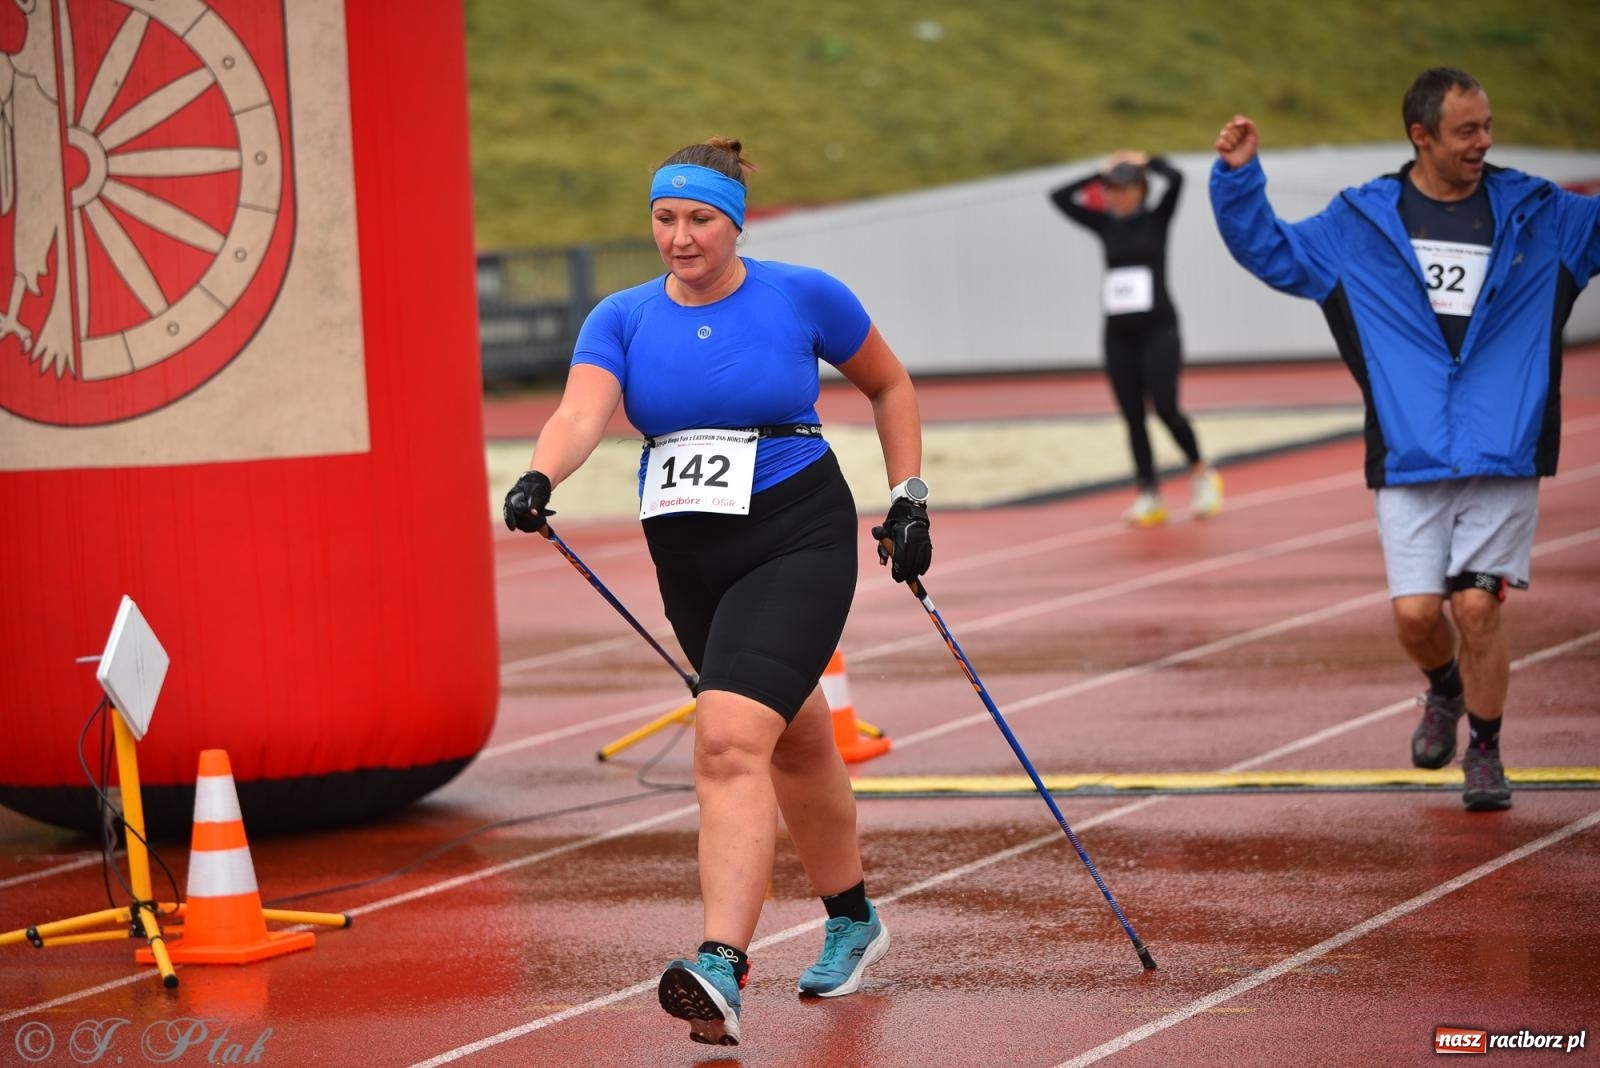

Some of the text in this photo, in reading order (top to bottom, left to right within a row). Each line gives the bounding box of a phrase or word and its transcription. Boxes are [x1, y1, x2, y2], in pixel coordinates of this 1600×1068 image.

[1426, 263, 1466, 293] 32
[660, 454, 731, 489] 142
[659, 496, 702, 508] Racibórz
